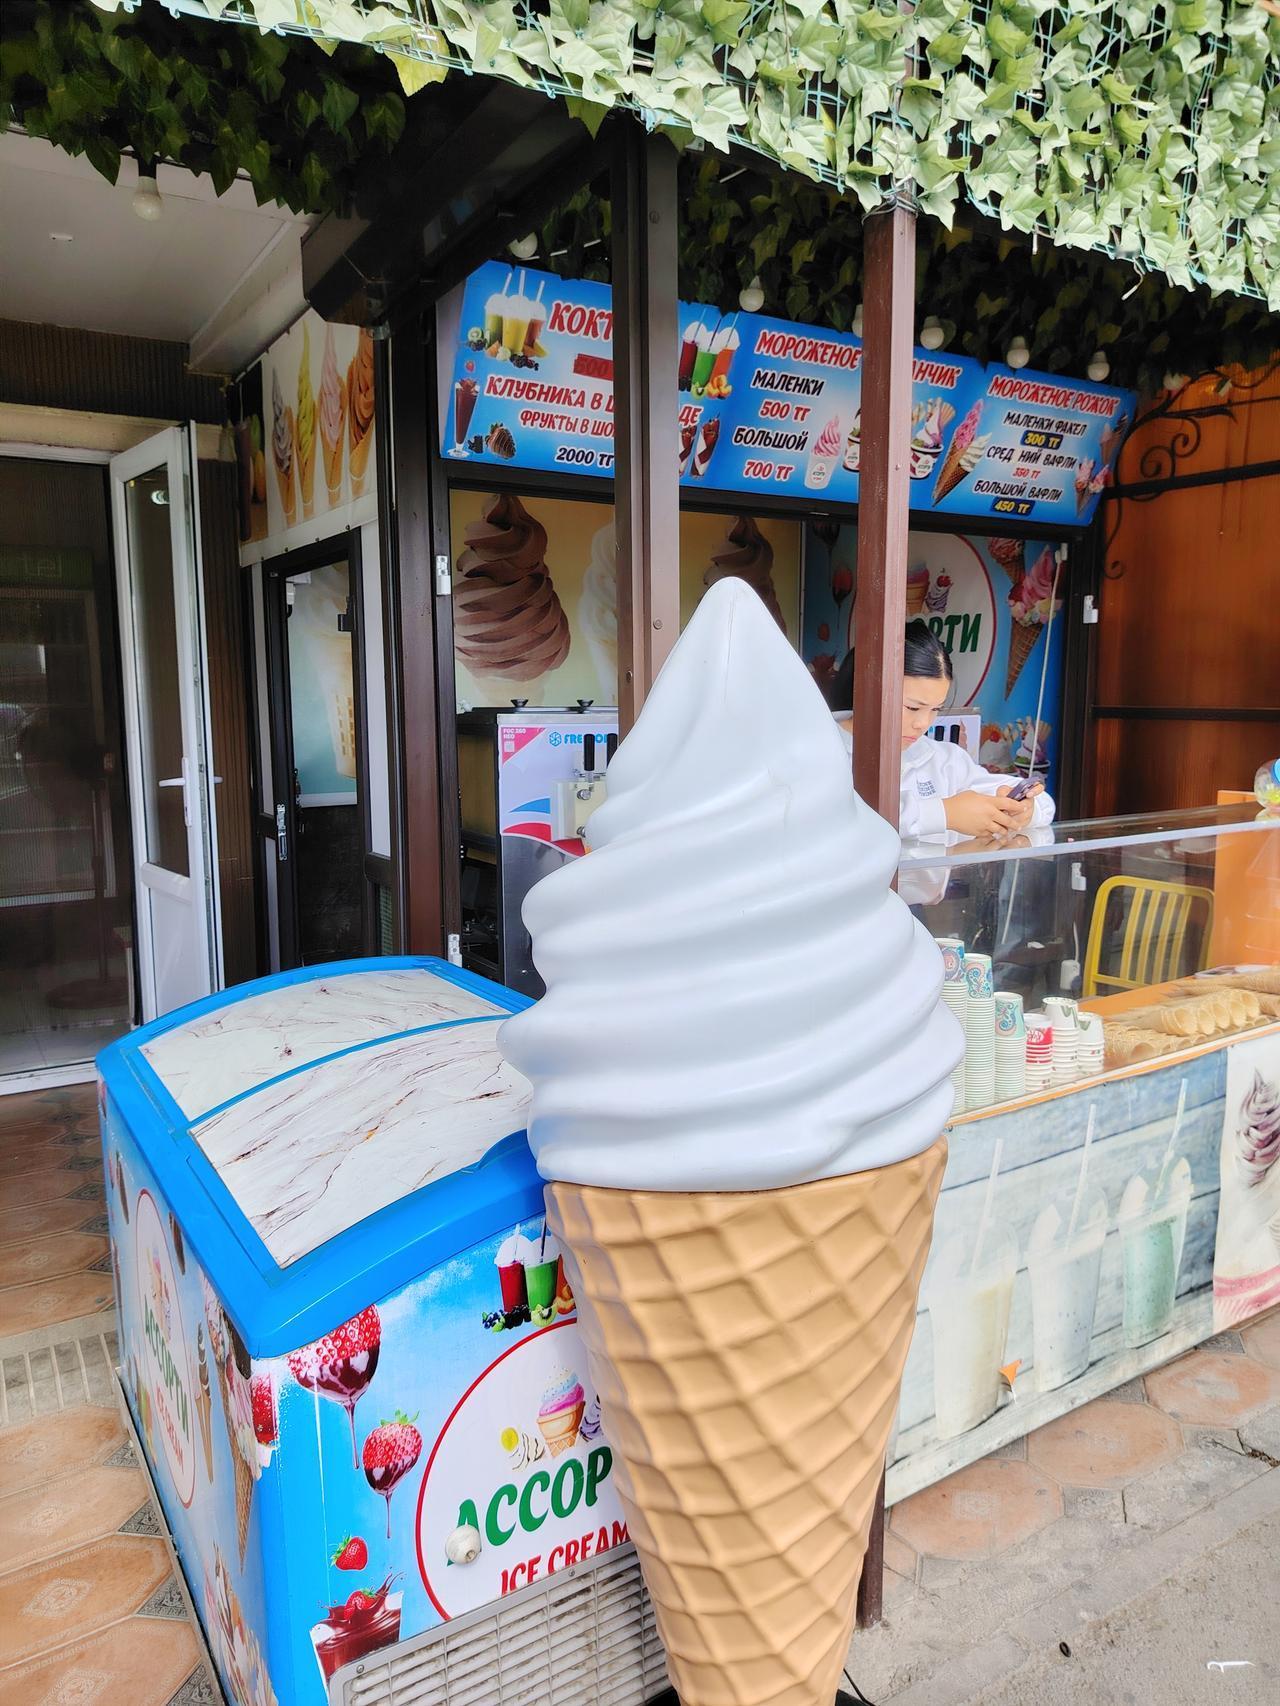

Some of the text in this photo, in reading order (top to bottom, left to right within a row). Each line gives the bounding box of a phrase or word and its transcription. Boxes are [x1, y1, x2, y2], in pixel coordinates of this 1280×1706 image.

[755, 331, 862, 368] МОРОЖЕНОЕ
[486, 376, 585, 408] КЛУБНИКА
[590, 392, 603, 411] В
[752, 370, 825, 396] МАЛЕНКИ
[988, 376, 1121, 417] МОРОЖЕНОЕ РОЖОК
[760, 401, 790, 419] 500
[1003, 412, 1053, 430] МАЛЕНКИ
[520, 409, 614, 438] ФРУКТЫ В ШО
[733, 426, 809, 452] БОЛЬШОЙ
[1024, 432, 1045, 446] 300
[556, 447, 595, 465] 2000
[986, 446, 1078, 469] СРЕД НИЙ ВАФЛИ
[744, 460, 773, 479] 700
[974, 480, 1063, 501] БОЛЬШОЙ ВАФЛИ
[993, 500, 1014, 512] 450
[914, 613, 982, 653] РТИ
[500, 1519, 632, 1598] ICE CREAM
